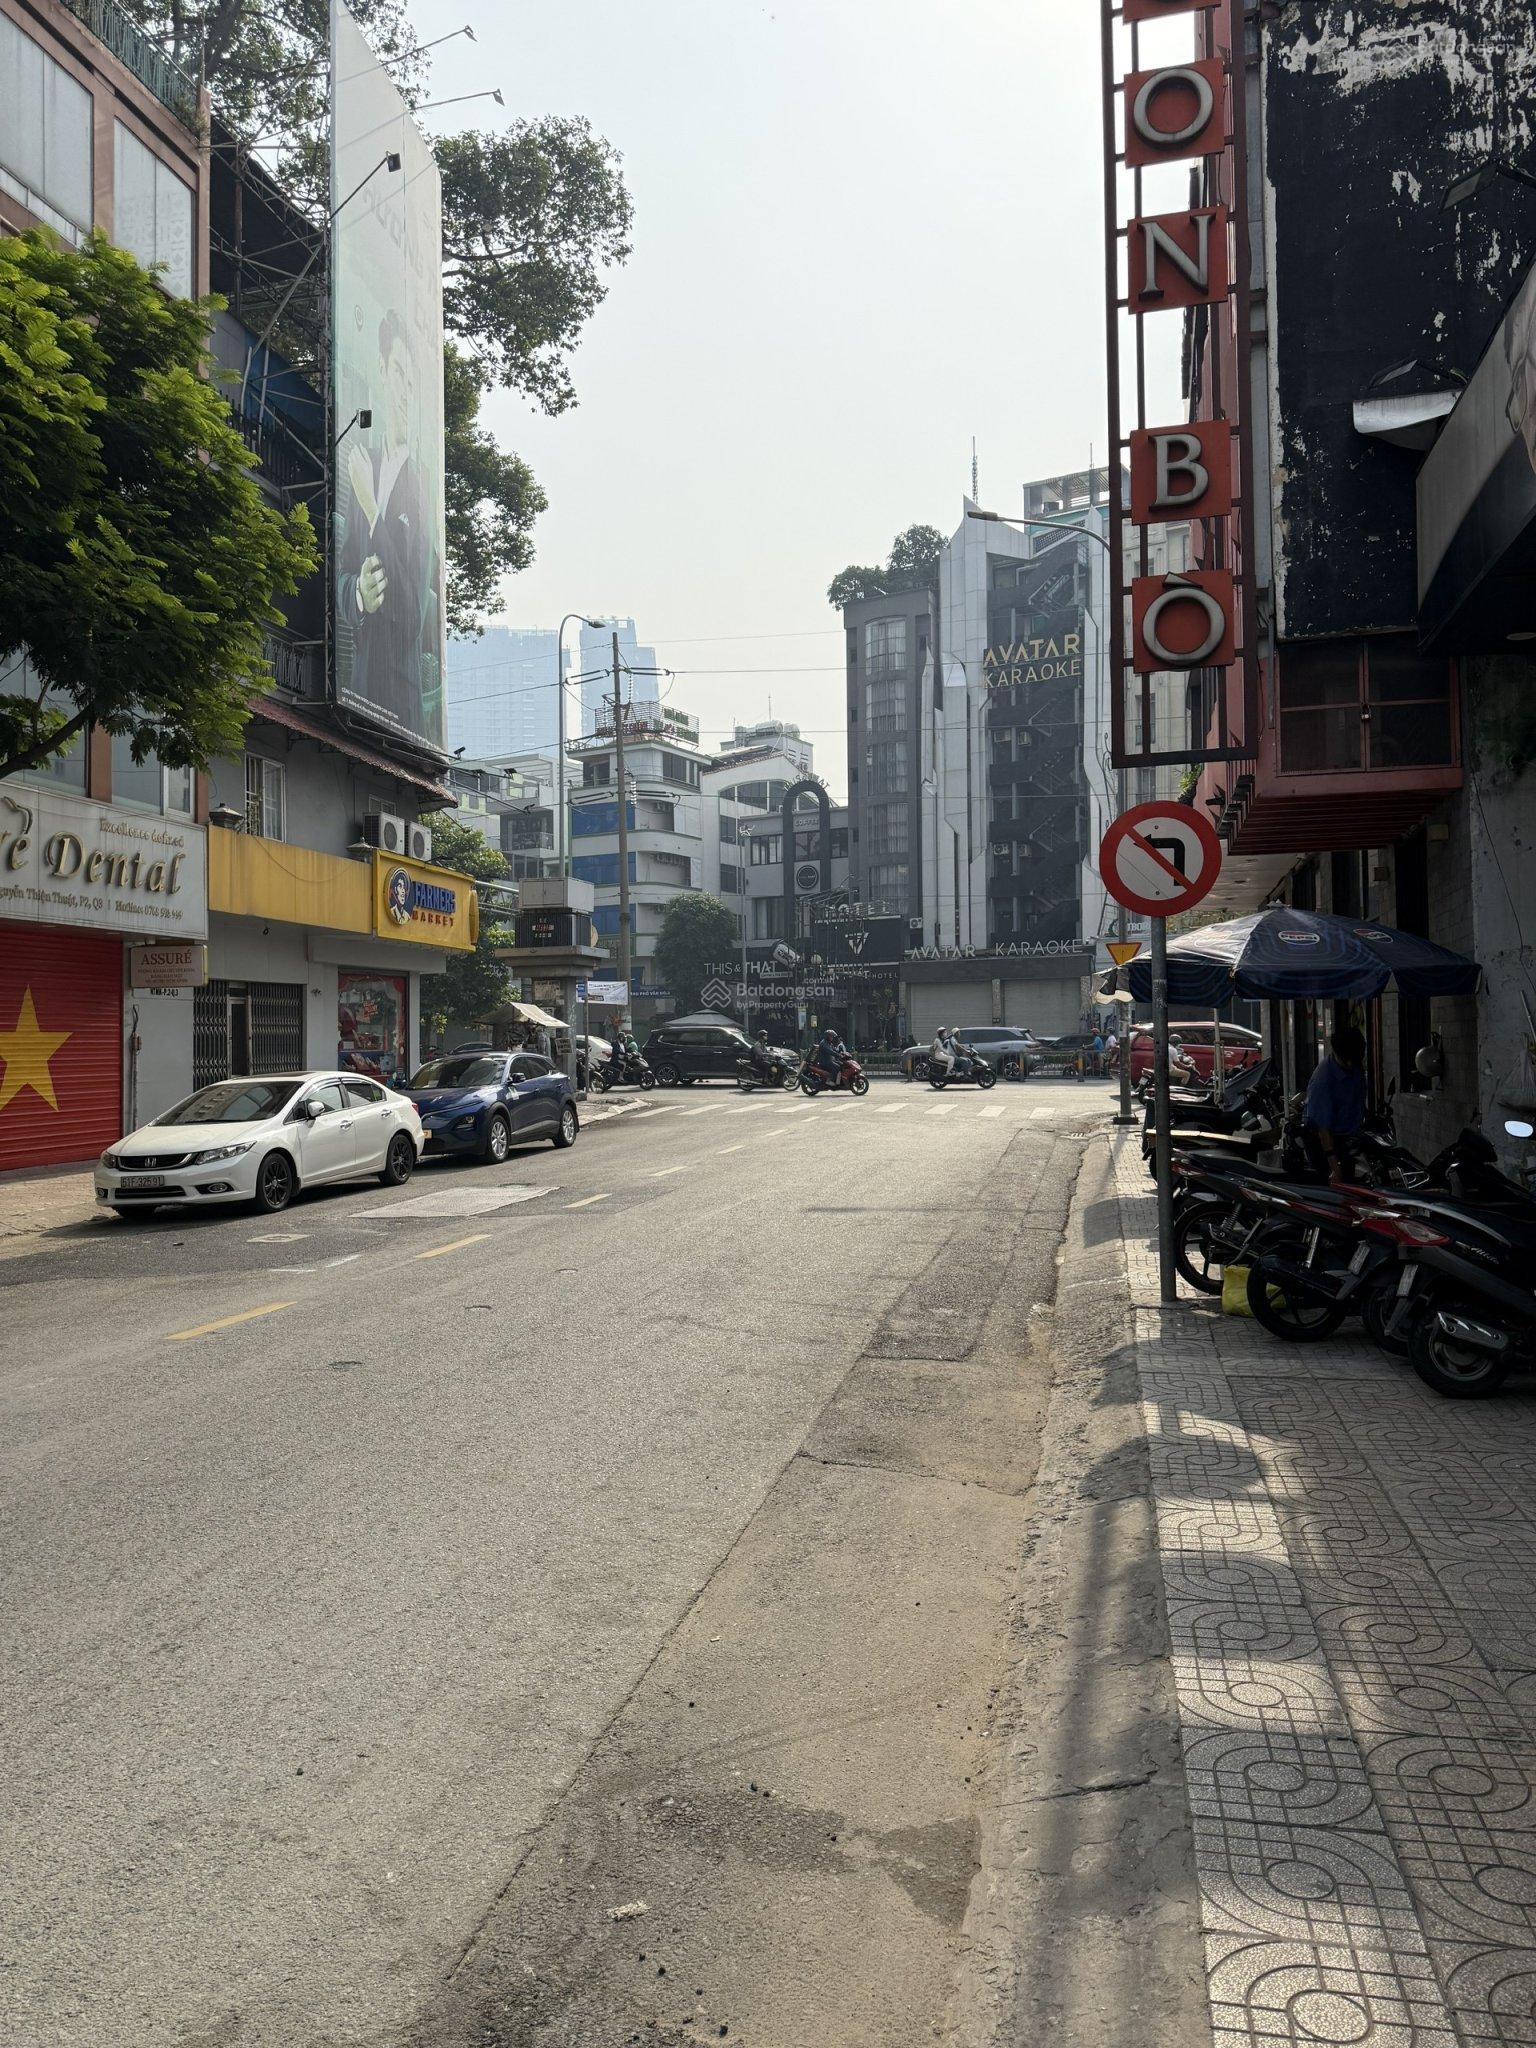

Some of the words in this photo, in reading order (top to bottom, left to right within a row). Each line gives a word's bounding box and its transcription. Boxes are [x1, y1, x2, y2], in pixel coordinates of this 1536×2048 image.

[983, 633, 1080, 668] AVATAR
[982, 658, 1082, 690] KARAOKE
[99, 816, 150, 842] Excellence
[45, 830, 187, 898] Dental
[0, 884, 24, 901] guyễn
[414, 882, 456, 914] FARMERS
[411, 910, 455, 928] MARKET
[1280, 933, 1318, 942] PEPSI
[141, 948, 193, 966] ASSURÉ
[911, 943, 976, 960] AVATAR
[995, 938, 1083, 957] KARAOKE
[703, 961, 733, 976] THIS
[734, 963, 742, 973] &
[744, 960, 778, 975] THAT
